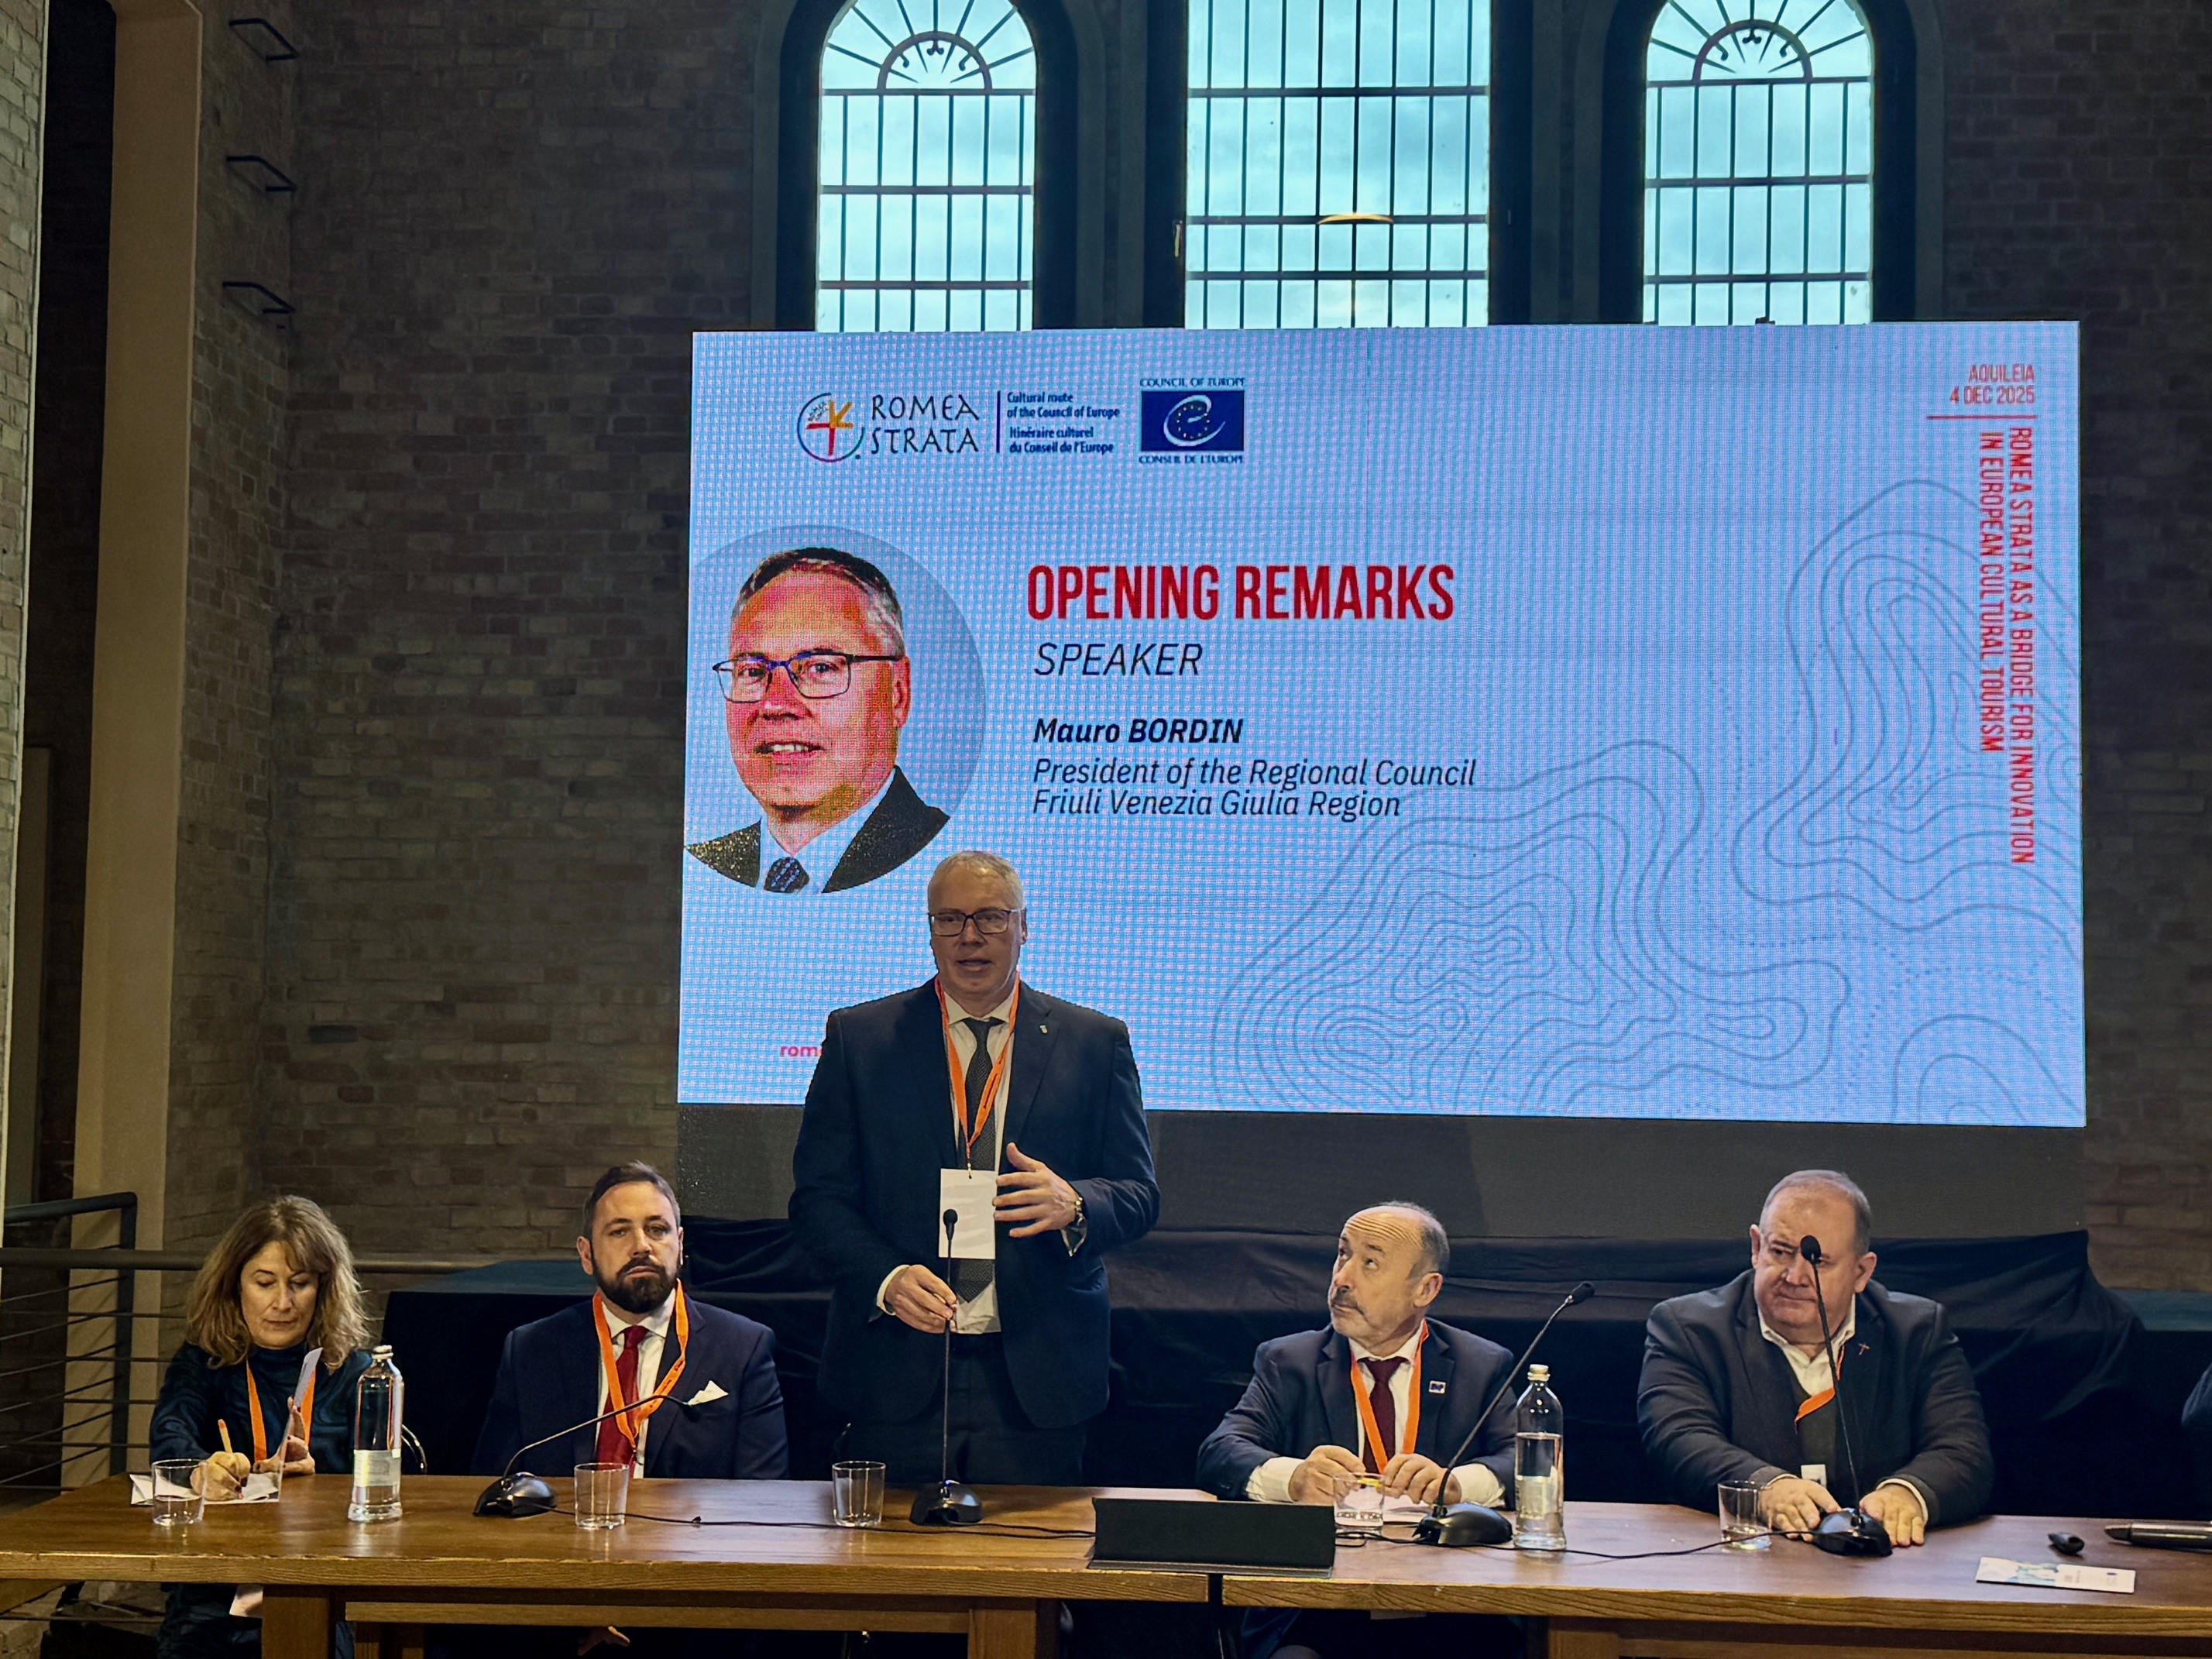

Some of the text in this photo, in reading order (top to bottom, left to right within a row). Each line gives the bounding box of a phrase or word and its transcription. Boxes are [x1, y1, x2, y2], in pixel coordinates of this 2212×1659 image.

[1969, 363, 2035, 383] AQUILEIA
[871, 394, 979, 421] ROMEA
[1007, 392, 1073, 403] Cultural route
[1949, 385, 2035, 404] 4 DEC 2025
[1007, 407, 1120, 419] of the Council of Europe
[871, 427, 979, 454] STRATA
[1056, 427, 1094, 438] culturel
[1009, 442, 1022, 453] du
[1024, 441, 1058, 453] Conseil
[1060, 441, 1072, 453] de
[1027, 565, 1455, 620] OPENING REMARKS
[1980, 432, 2005, 751] IN EUROPEAN CULTURAL TOURISM
[2010, 428, 2035, 863] ROMEA STRATA AS A BRIDGE FOR INNOVATION
[1034, 642, 1203, 676] SPEAKER
[1033, 718, 1244, 744] Mauro BORDIN
[1033, 757, 1477, 791] President of the Regional Council
[1033, 788, 1401, 822] Friuli Venezia Giulia Region
[780, 1046, 823, 1057] rom
